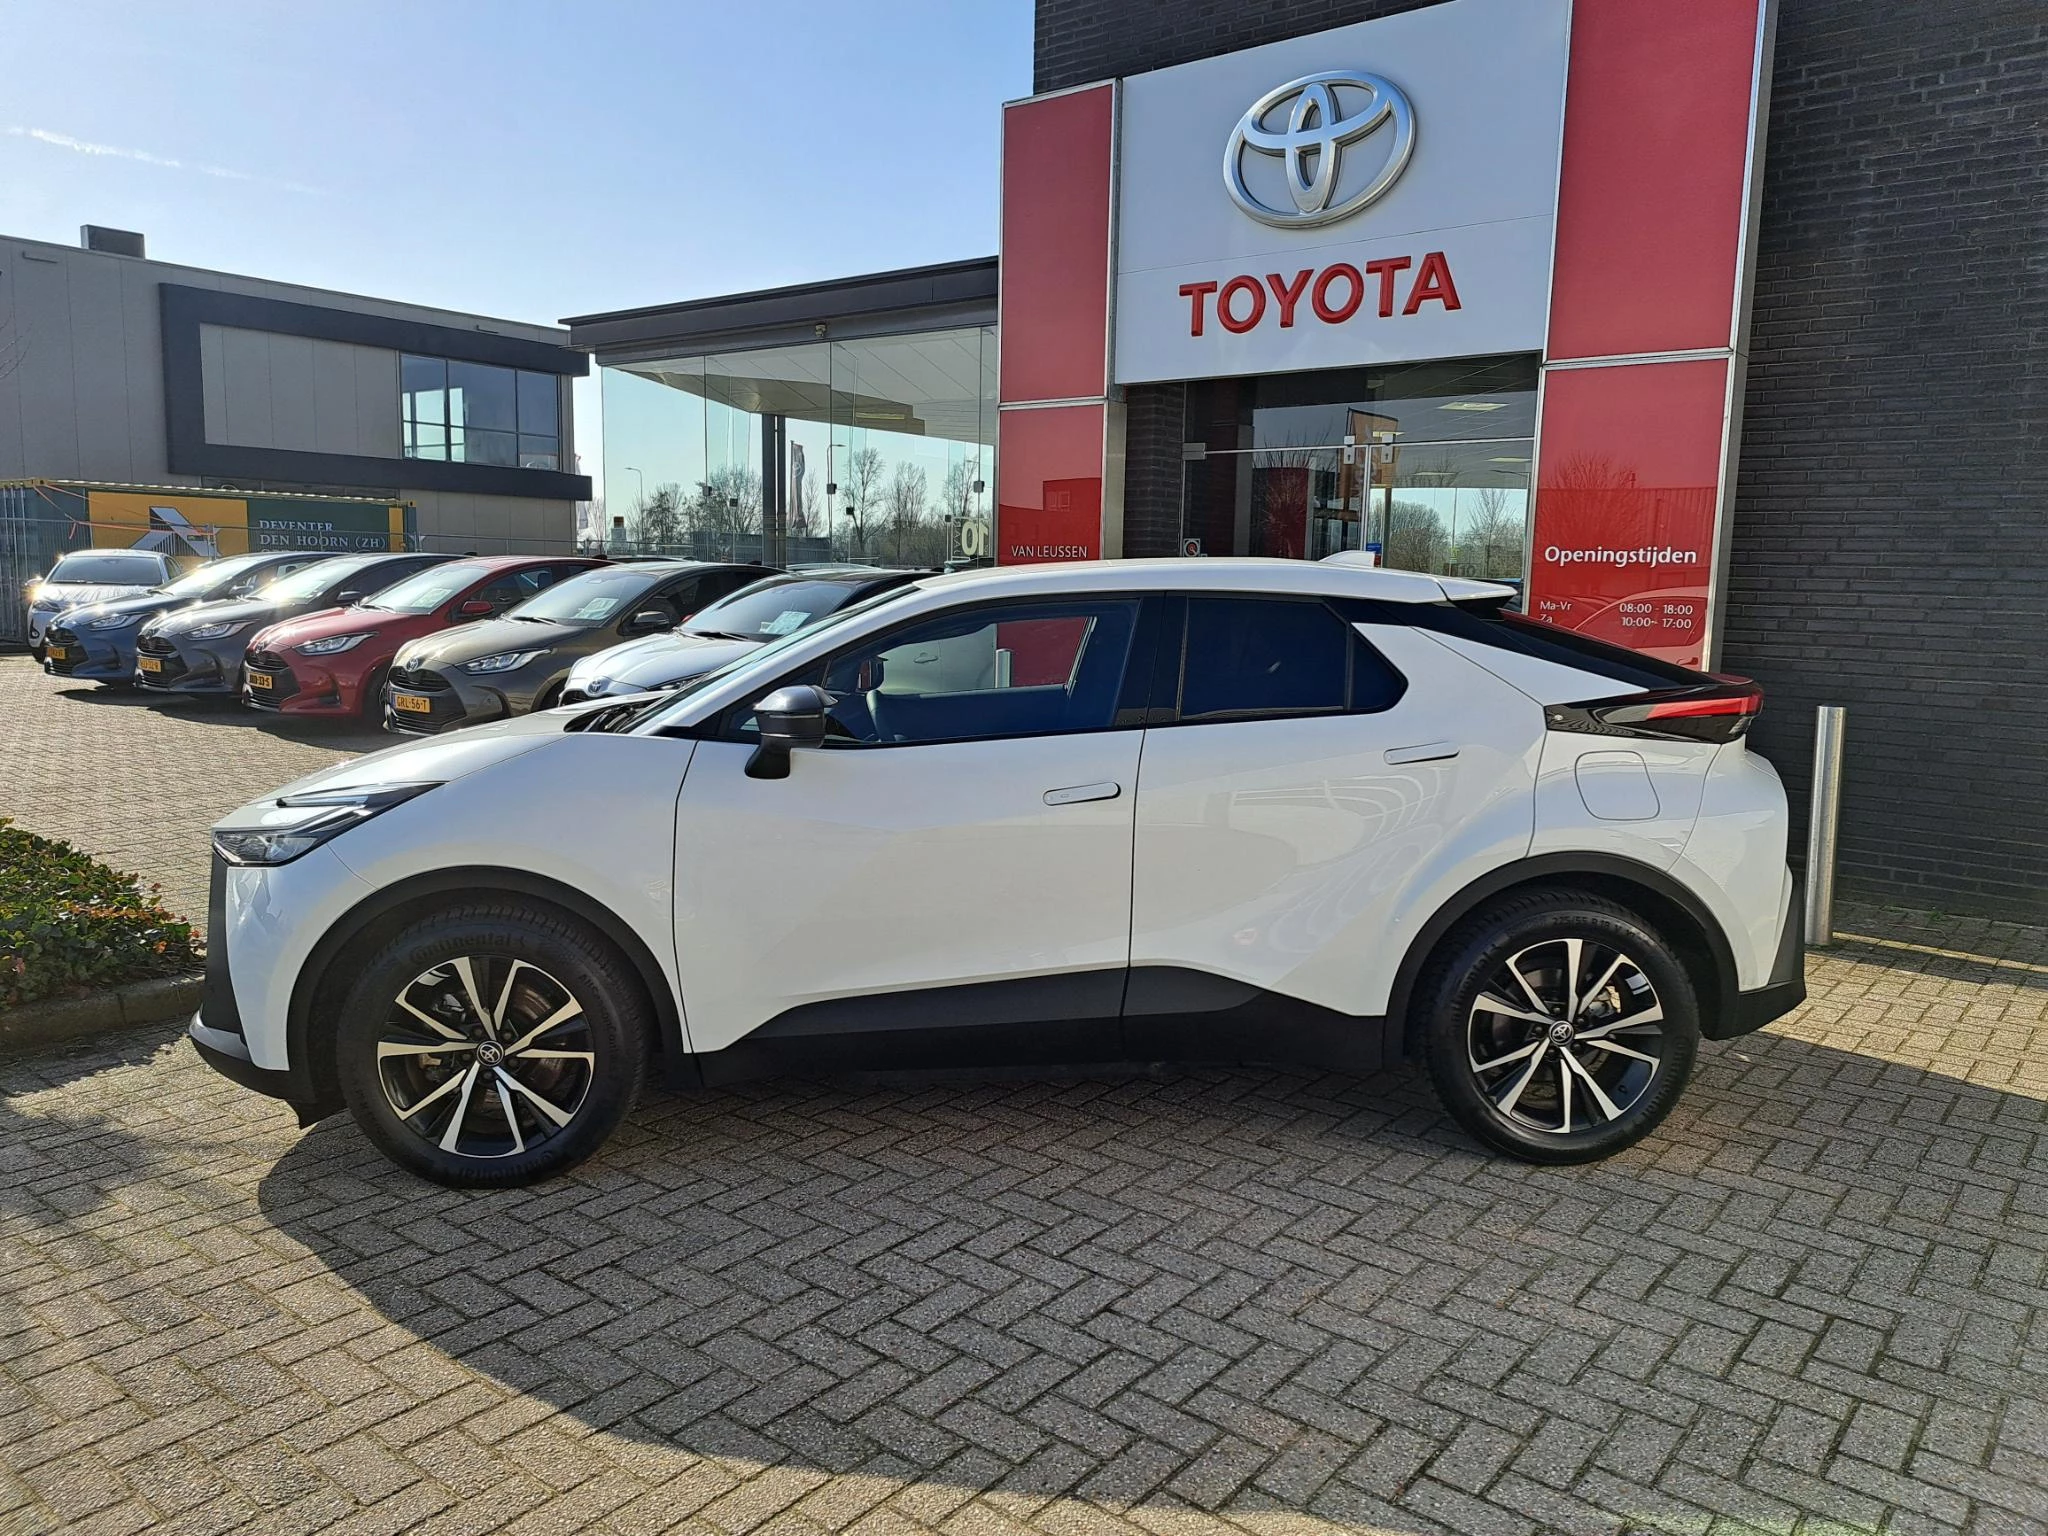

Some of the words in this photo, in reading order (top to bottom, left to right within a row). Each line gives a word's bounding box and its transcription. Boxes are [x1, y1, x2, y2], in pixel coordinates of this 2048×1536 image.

[1179, 251, 1461, 337] TOYOTA
[259, 519, 334, 532] DEVENTER
[260, 534, 290, 546] DEN
[296, 535, 348, 548] HOORN
[355, 536, 386, 550] (ZH)
[1011, 545, 1034, 557] VAN
[1037, 545, 1088, 558] LEUSSEN
[1544, 546, 1697, 568] Openingstijden
[1540, 601, 1572, 611] Ma-Vr
[1619, 603, 1652, 614] 08:00
[1664, 604, 1693, 615] 18:00
[1539, 614, 1553, 624] Za
[1621, 616, 1651, 628] 10:00
[1662, 618, 1692, 629] 17:00
